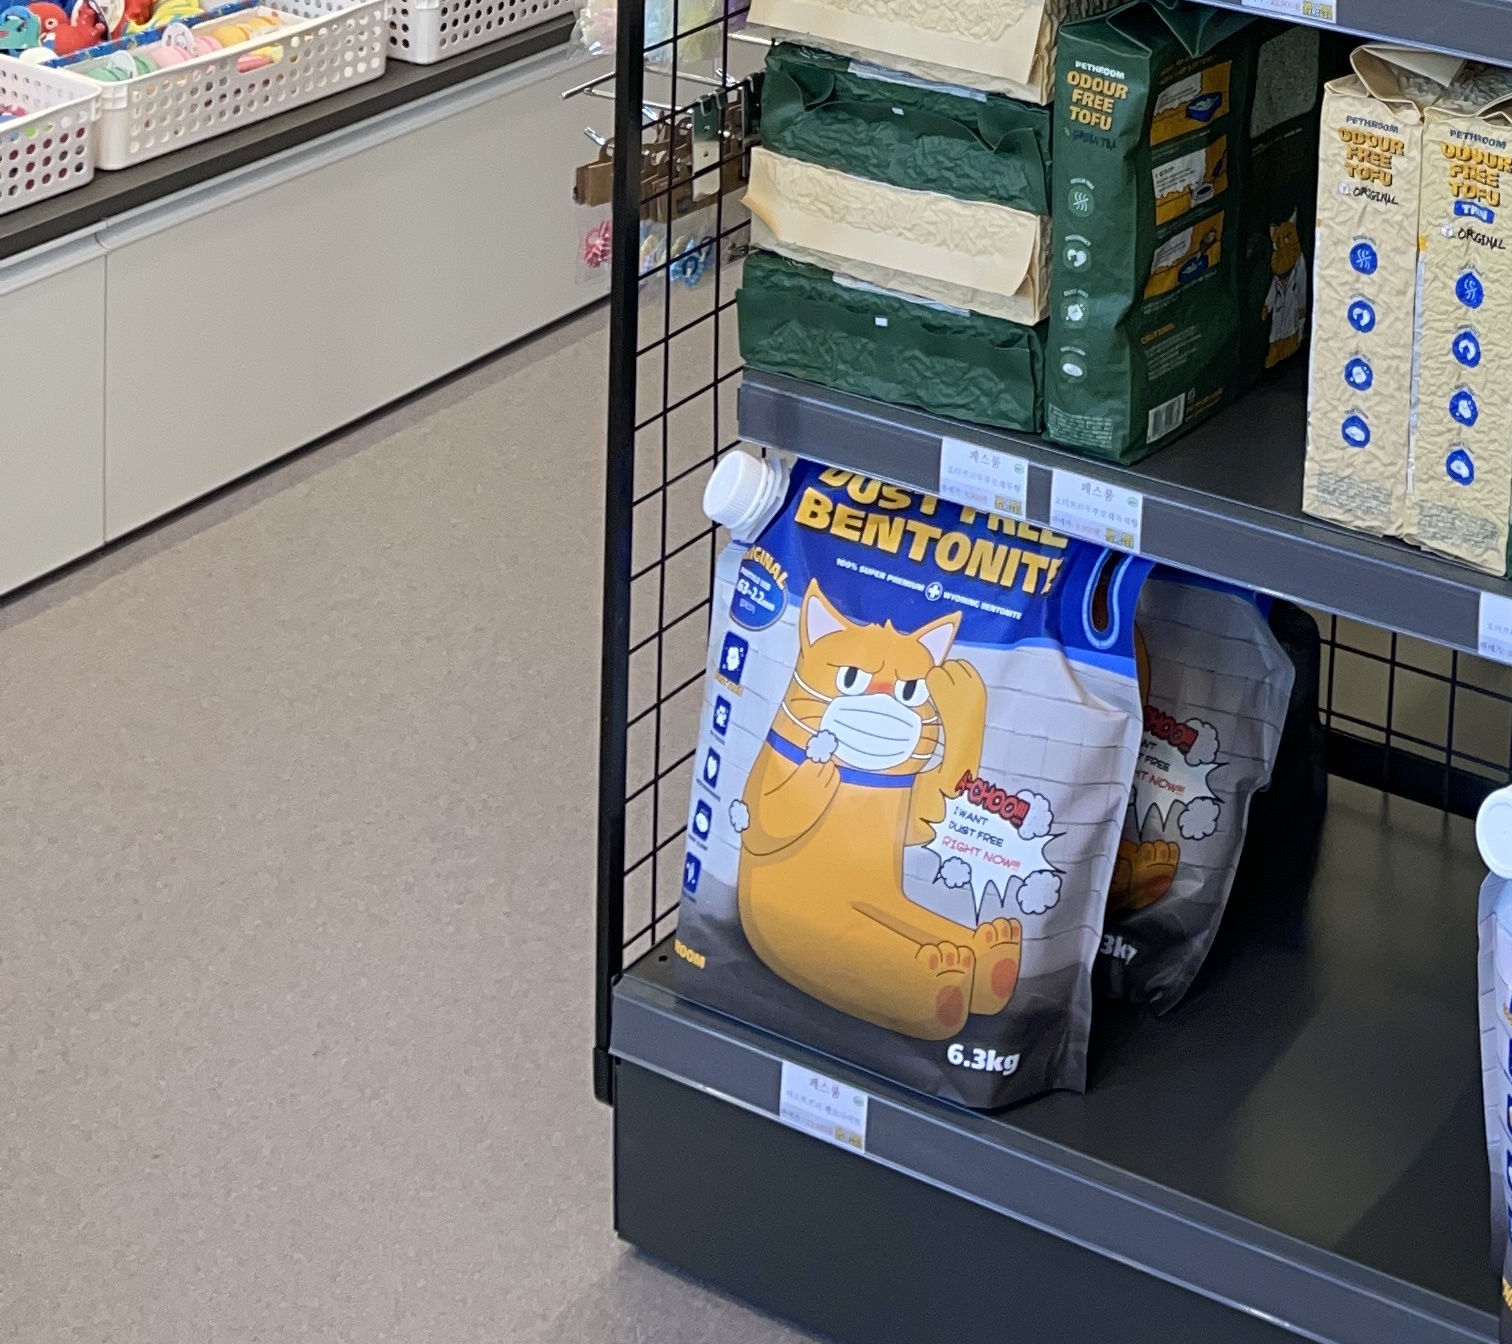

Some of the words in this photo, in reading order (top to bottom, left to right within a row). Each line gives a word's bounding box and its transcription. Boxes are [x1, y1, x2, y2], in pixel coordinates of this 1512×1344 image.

[1075, 61, 1125, 80] PETHROOM
[1066, 70, 1129, 100] ODOUR
[1071, 88, 1115, 113] FREE
[1069, 105, 1112, 131] TOFU
[1346, 115, 1399, 134] PETHROOM
[1338, 126, 1406, 157] ODOUR
[1449, 128, 1507, 150] PETHROOM
[1345, 146, 1393, 170] FREE
[1344, 163, 1393, 188] TOFU
[1449, 162, 1501, 189] FREE
[1448, 180, 1501, 207] TOFU
[968, 450, 1001, 469] 페스룸
[1081, 482, 1114, 501] 페스룸
[795, 487, 1064, 595] BENTONIT
[859, 565, 886, 580] SUPER
[887, 573, 925, 592] PREMIUM
[943, 591, 980, 609] WYOMING
[981, 599, 1022, 620] BENTONITE
[960, 808, 988, 825] WANT
[942, 836, 982, 858] RIGHT
[949, 821, 976, 839] DUST
[977, 830, 1003, 848] FREE
[947, 1043, 1021, 1076] 6.3kg
